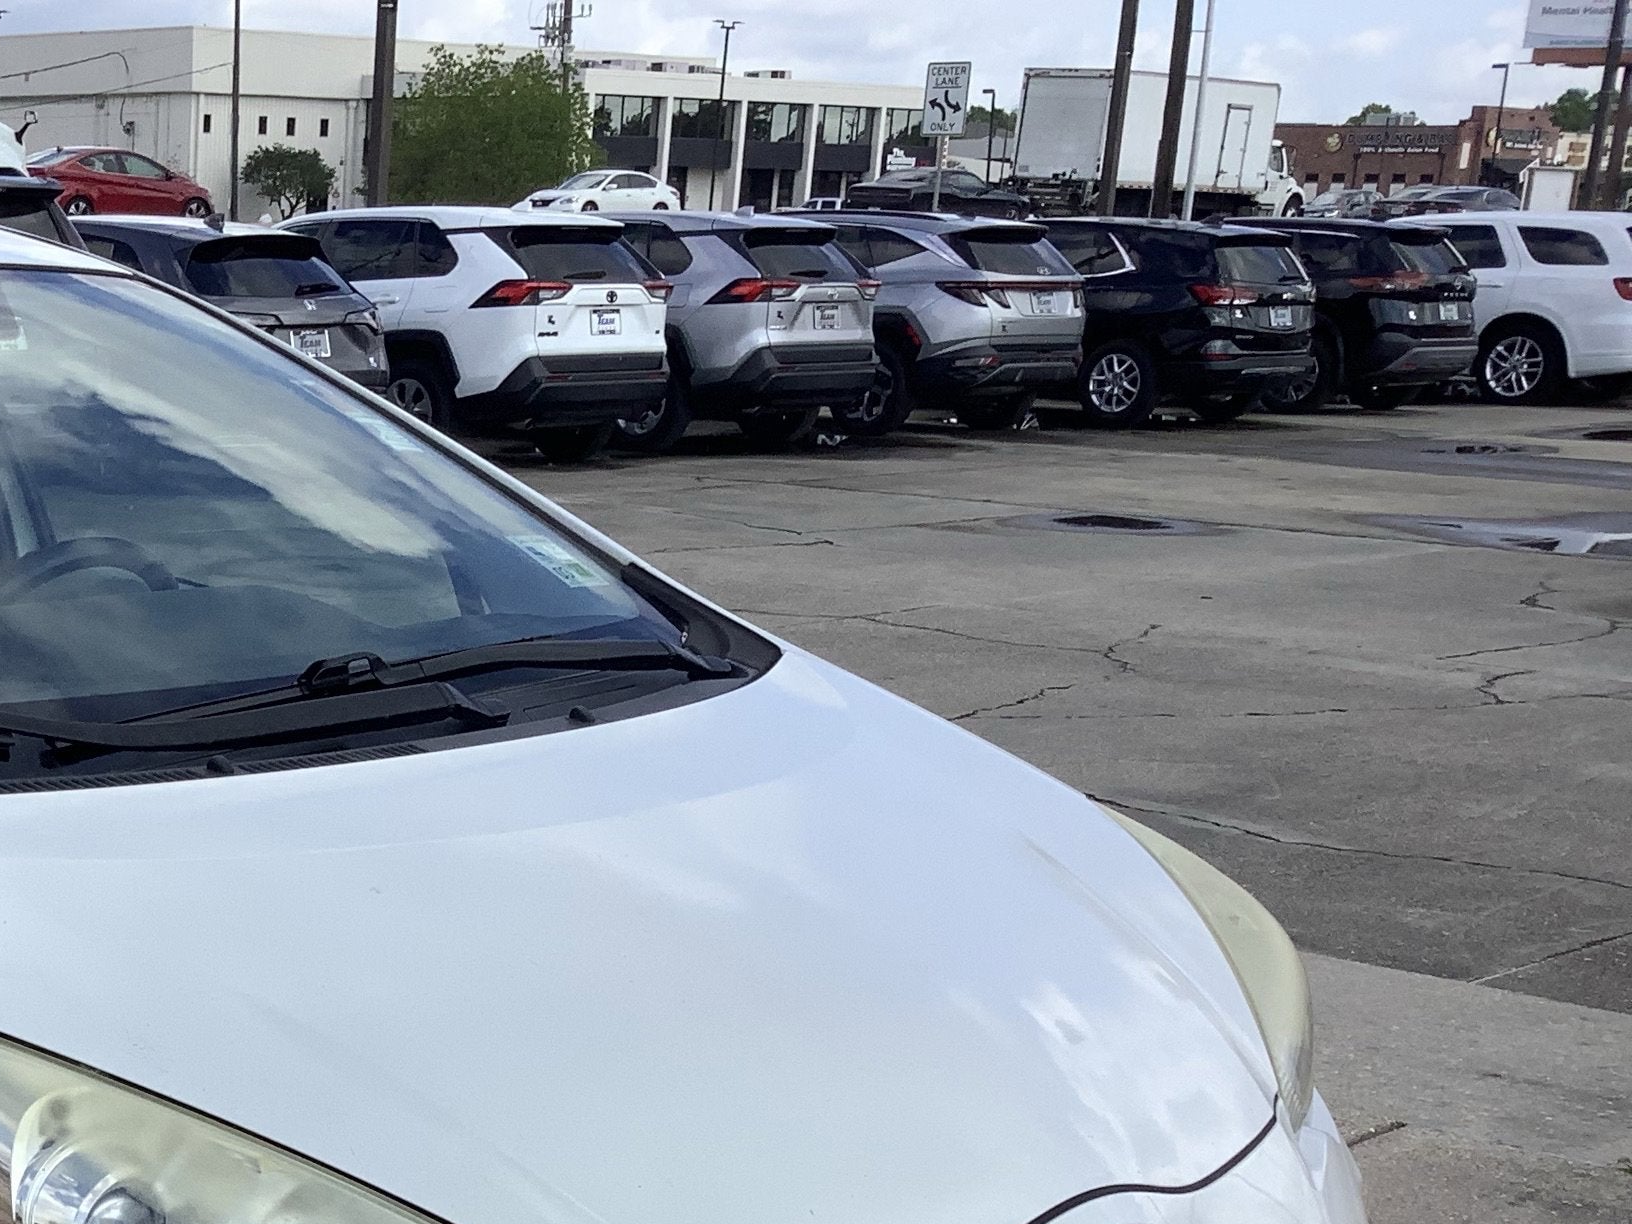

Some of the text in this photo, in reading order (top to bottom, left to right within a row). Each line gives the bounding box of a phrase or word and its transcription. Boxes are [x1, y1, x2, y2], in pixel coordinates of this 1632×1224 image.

[931, 66, 967, 76] CENTER
[935, 77, 960, 86] LANE
[930, 122, 955, 131] ONLY
